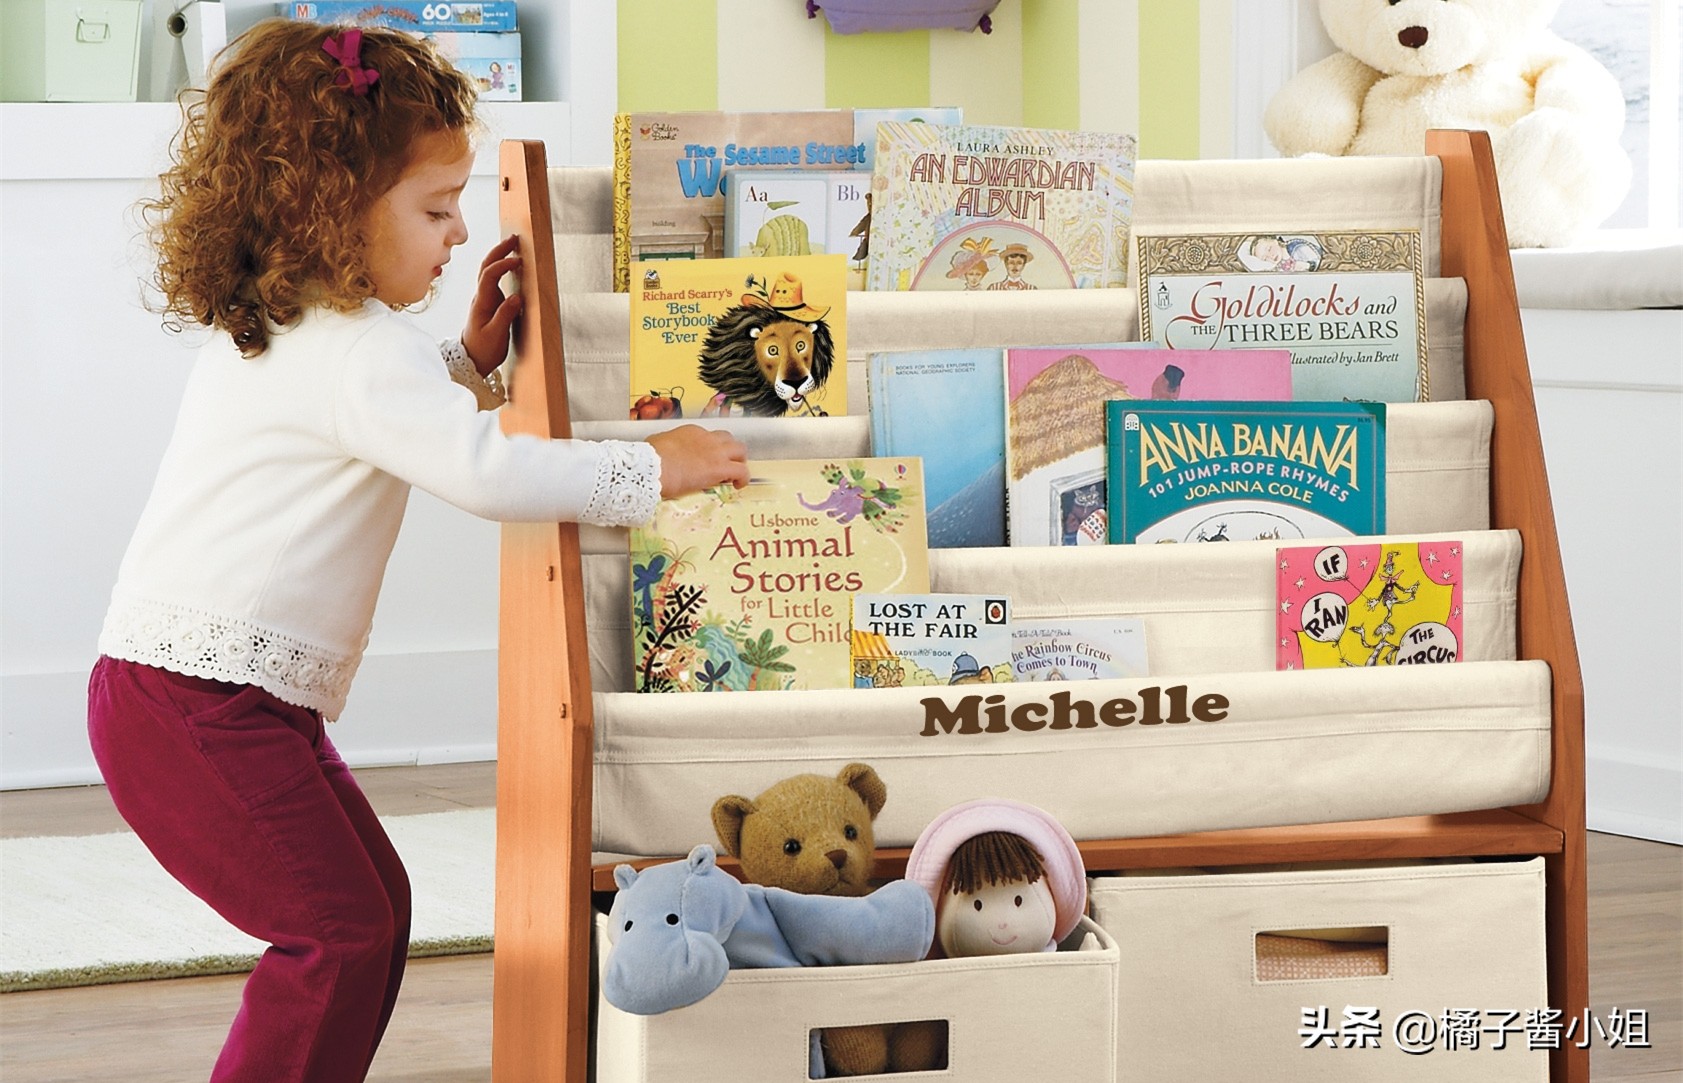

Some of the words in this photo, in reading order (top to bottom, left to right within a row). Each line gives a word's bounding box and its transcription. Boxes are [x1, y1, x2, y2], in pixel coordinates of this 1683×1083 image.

[296, 4, 318, 19] MB
[422, 3, 451, 21] 60
[651, 123, 680, 133] Golden
[684, 144, 717, 159] The
[724, 143, 801, 166] Sesame
[805, 142, 866, 165] Street
[957, 142, 1000, 154] LAURA
[1003, 144, 1055, 156] ASHLEY
[676, 157, 728, 199] W
[909, 153, 946, 184] AN
[952, 155, 1096, 192] EDWARDIAN
[745, 185, 769, 203] Aa
[837, 184, 861, 203] Bb
[954, 187, 1046, 221] ALBUM
[643, 290, 686, 302] Richard
[688, 288, 733, 301] Scarry's
[665, 301, 702, 315] Best
[1167, 281, 1361, 342] Goldilocks
[1364, 296, 1398, 316] and
[642, 313, 717, 331] Storybook
[1190, 325, 1218, 337] THE
[1223, 322, 1314, 344] THREE
[1319, 319, 1400, 342] BEARS
[661, 331, 699, 344] Ever
[1289, 351, 1339, 365] llustrated
[1339, 351, 1353, 367] by
[1353, 351, 1373, 363] Jan
[1374, 350, 1399, 363] Brett
[1139, 421, 1229, 488] ANNA
[1232, 423, 1361, 492] BANANA
[1149, 477, 1174, 499] 101
[1177, 461, 1276, 486] JUMP-ROPE
[1280, 464, 1351, 503] RHYMES
[1184, 480, 1265, 501] JOANNA
[1267, 482, 1314, 504] COLE
[750, 514, 819, 528] Usborne
[709, 526, 856, 561] Animal
[1322, 553, 1341, 576] IF
[730, 562, 864, 595] Stories
[740, 596, 763, 613] for
[768, 597, 834, 619] Little
[869, 602, 928, 619] LOST
[936, 604, 967, 620] AT
[1313, 597, 1322, 616] I
[868, 621, 916, 638] THE
[925, 623, 978, 639] FAIR
[1305, 604, 1348, 639] RAN
[1409, 627, 1435, 645] THE
[1011, 651, 1024, 662] he
[1025, 638, 1073, 659] Rainbow
[1076, 642, 1112, 663] Circus
[1016, 659, 1053, 674] Comes
[1055, 659, 1067, 668] to
[1068, 655, 1099, 675] Town
[919, 684, 1230, 737] Michelle
